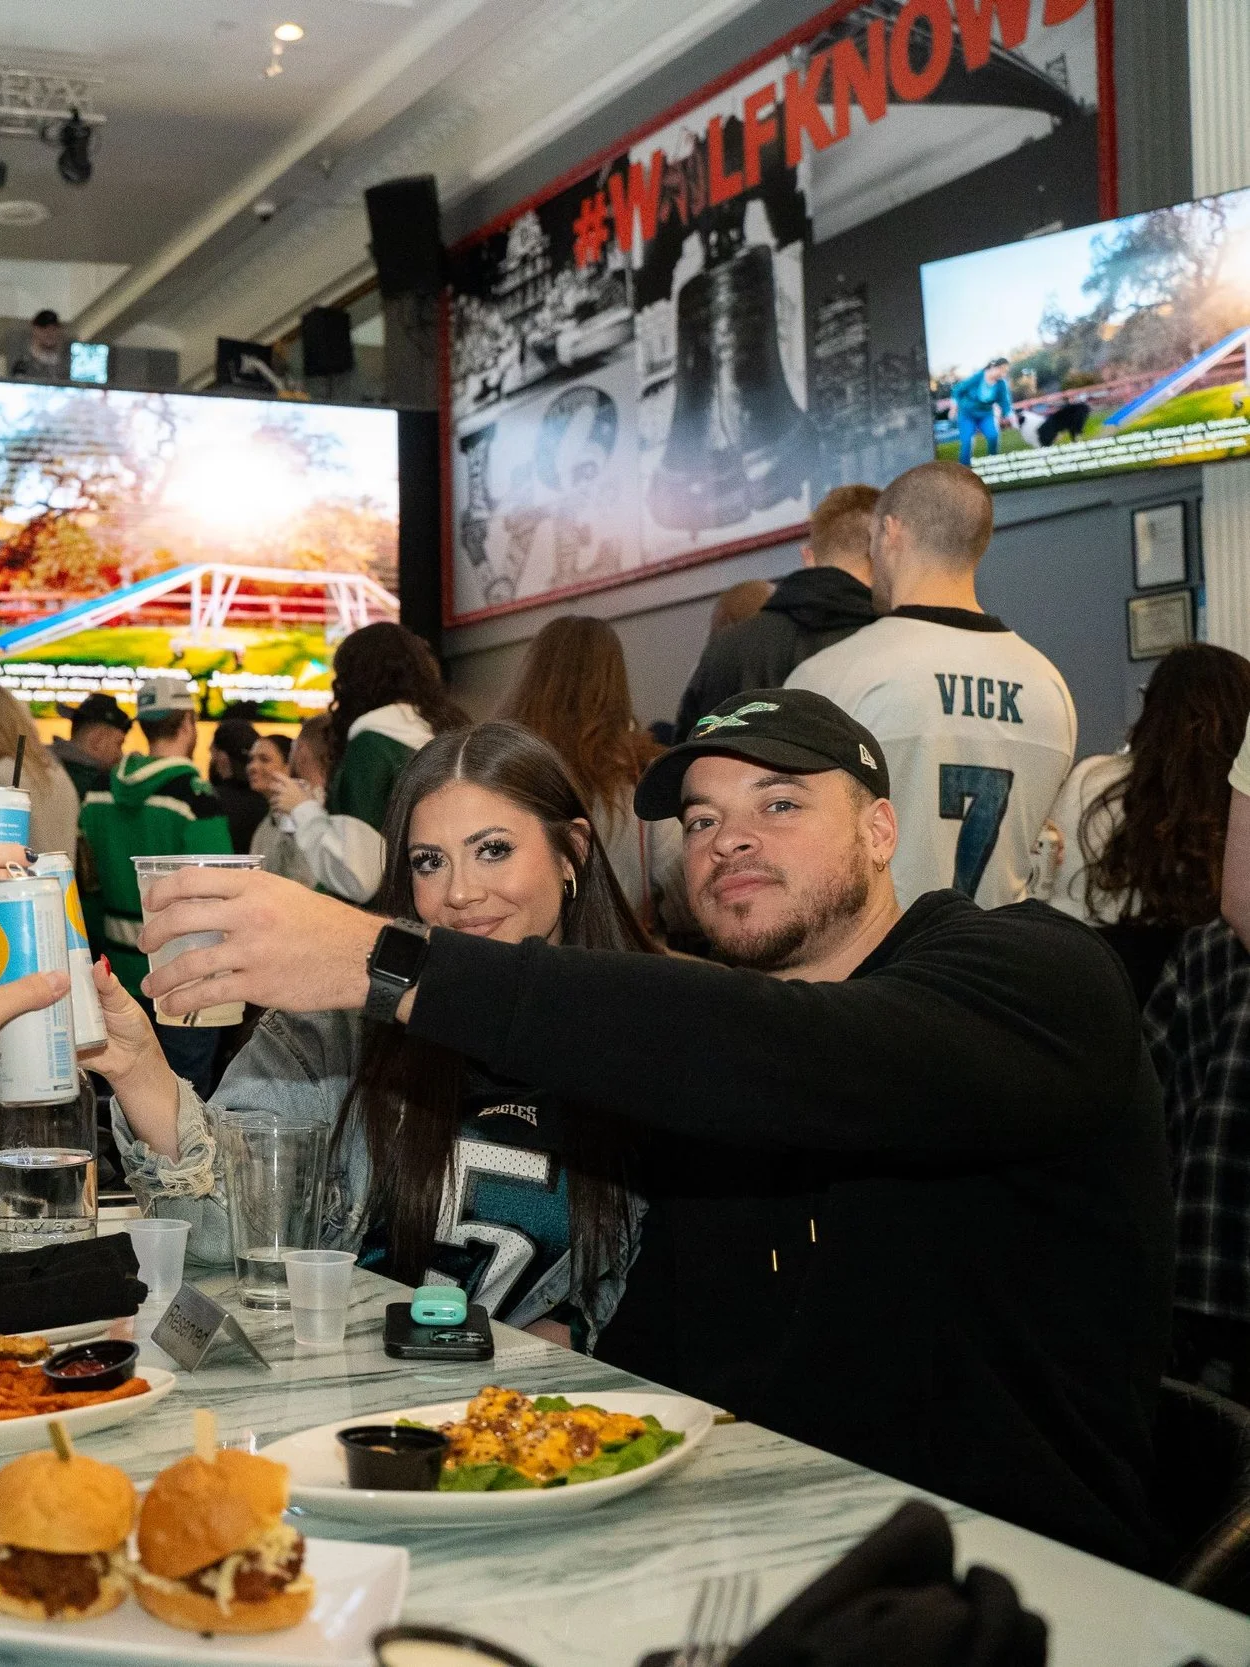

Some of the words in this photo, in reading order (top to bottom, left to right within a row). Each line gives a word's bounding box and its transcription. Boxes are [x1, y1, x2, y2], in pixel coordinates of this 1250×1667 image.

[573, 0, 1085, 269] #WLFKNOW
[934, 673, 1024, 725] VICK
[939, 763, 1015, 901] 7
[424, 1137, 550, 1319] 5
[164, 1303, 213, 1351] Reserved
